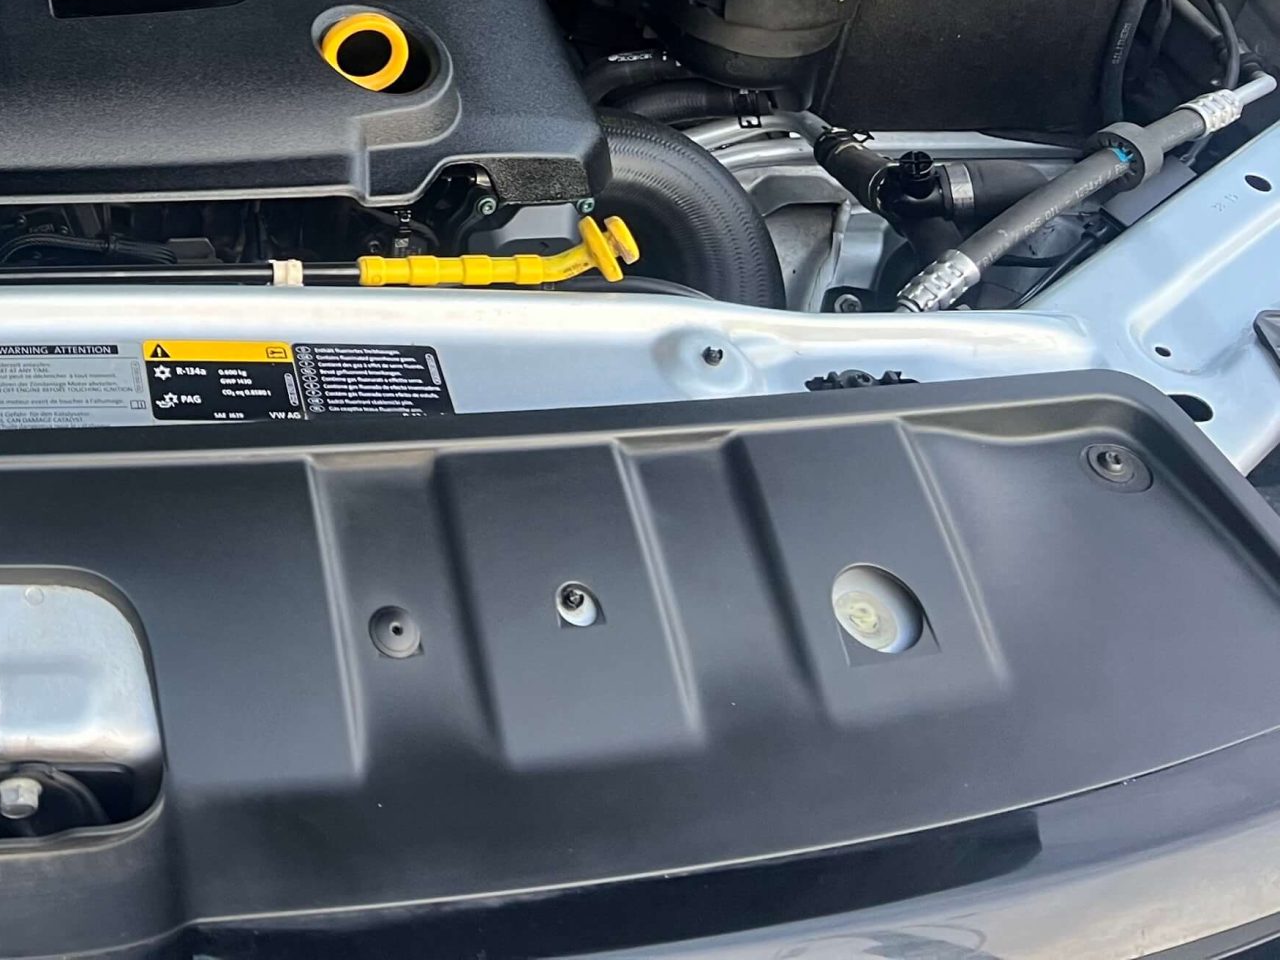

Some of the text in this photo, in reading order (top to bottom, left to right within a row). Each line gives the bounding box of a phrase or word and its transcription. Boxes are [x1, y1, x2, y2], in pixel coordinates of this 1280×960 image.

[53, 346, 112, 354] ATTENTION
[175, 367, 207, 376] R-134a
[180, 395, 202, 404] PAG
[268, 411, 301, 420] VW AG
